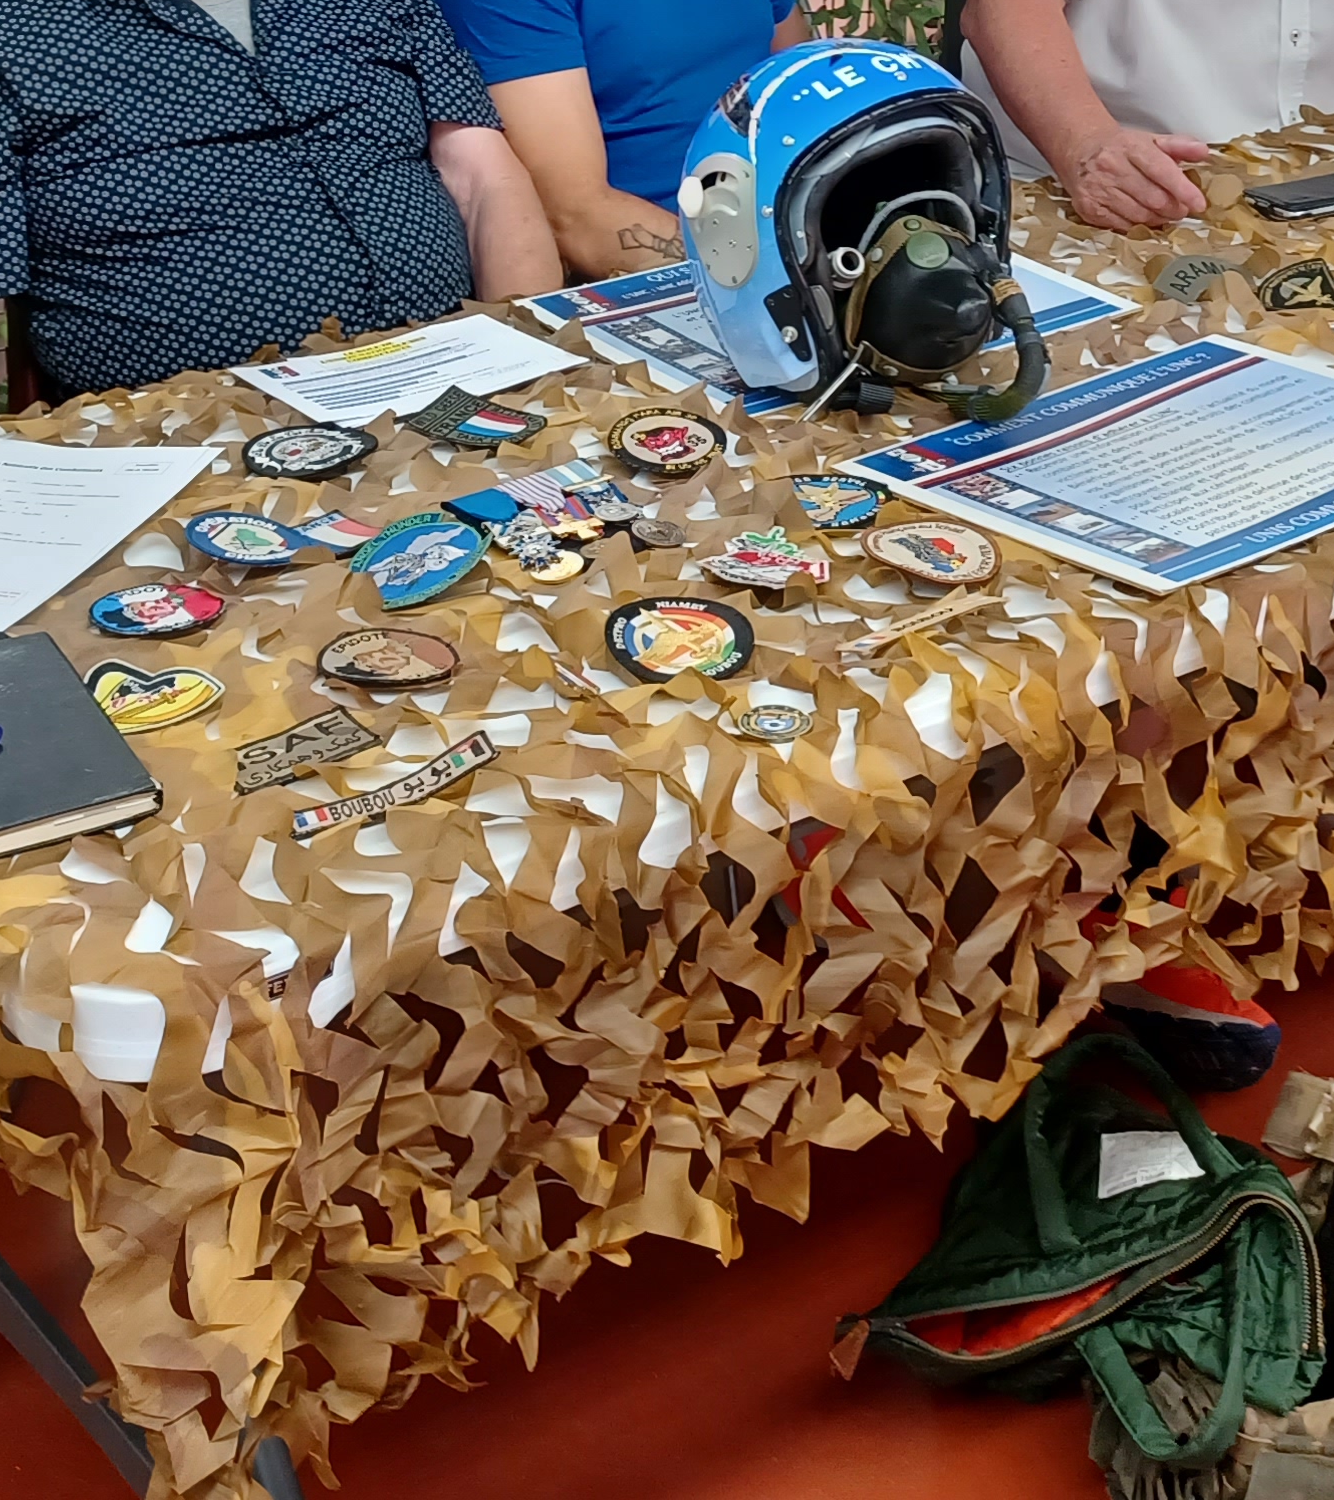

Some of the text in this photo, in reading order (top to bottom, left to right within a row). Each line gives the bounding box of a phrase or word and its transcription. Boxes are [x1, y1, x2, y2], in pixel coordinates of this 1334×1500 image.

[645, 269, 681, 283] QUI
[954, 411, 1041, 447] COMMENT
[1040, 372, 1154, 417] COMMUNIQUE
[1151, 355, 1199, 377] L'UNC
[431, 398, 487, 435] FRANCE
[193, 515, 278, 533] OPERATION
[1249, 521, 1289, 544] UNIS
[655, 599, 709, 613] NIAMEY
[242, 714, 344, 766] SAF
[328, 788, 397, 822] BOUBOU
